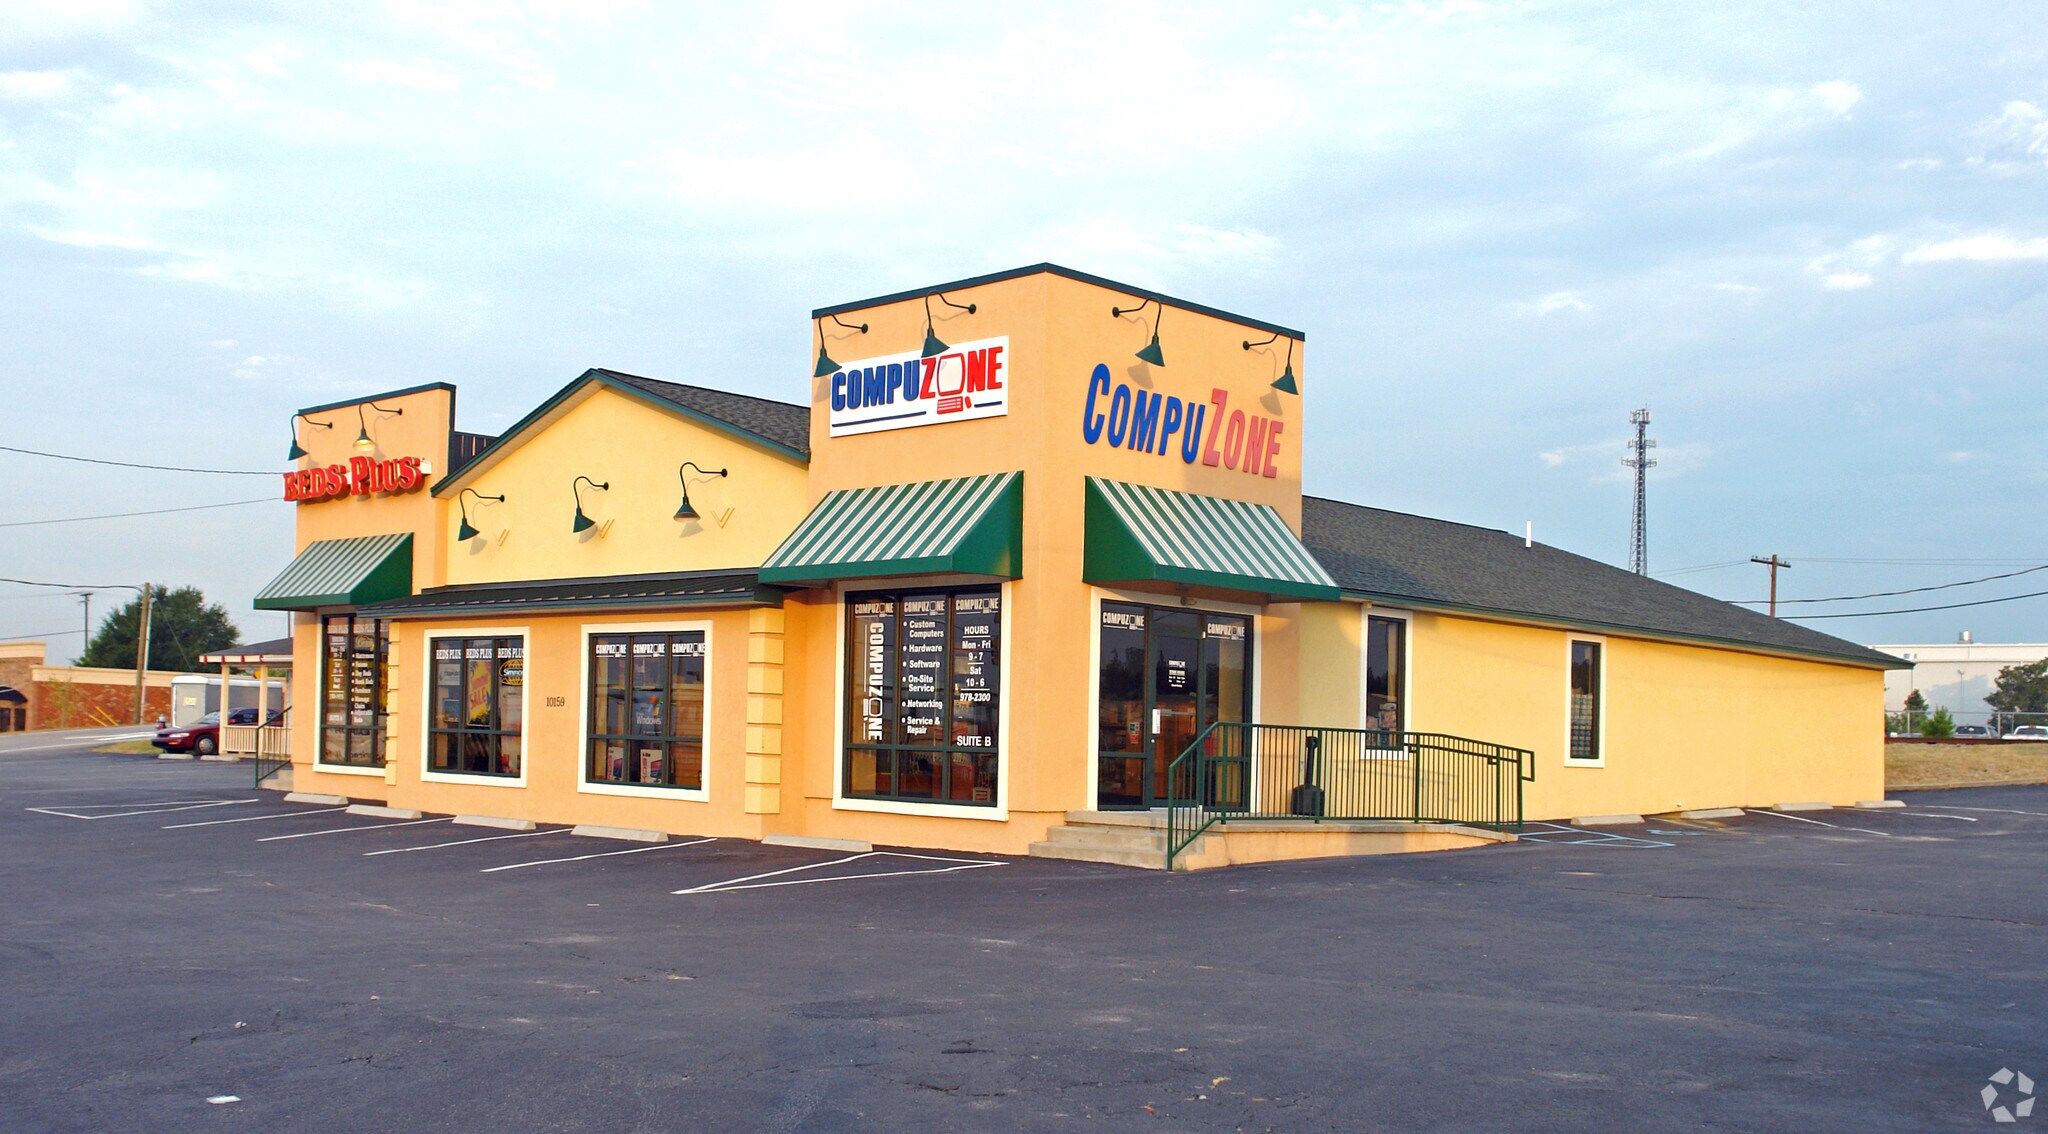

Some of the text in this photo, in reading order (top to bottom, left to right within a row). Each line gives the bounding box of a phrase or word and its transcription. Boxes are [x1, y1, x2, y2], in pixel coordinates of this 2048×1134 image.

[831, 345, 1003, 412] COMPUZONE
[283, 456, 423, 501] BEDS PLUS
[855, 602, 894, 615] COMPUZONE
[904, 601, 945, 614] COMPUZONE
[956, 598, 999, 611] COMPUZONE
[909, 620, 936, 628] Custom
[1103, 612, 1145, 627] COMPUZONE
[909, 630, 944, 639] Computers
[964, 626, 989, 635] HOURS
[1207, 623, 1245, 637] COMPUZONE
[595, 644, 627, 654] COMPUZONE
[633, 643, 665, 654] COMPUZONE
[909, 644, 943, 652] Hardware
[962, 640, 976, 649] Mon
[982, 640, 991, 649] Fri
[436, 649, 461, 659] BEDS PLUS
[466, 648, 493, 659] BEDS PLUS
[497, 647, 511, 658] BEDS
[968, 653, 973, 661] 9
[979, 652, 984, 661] 7
[909, 660, 940, 668] Software
[503, 668, 524, 677] Simmo
[969, 667, 982, 675] Sat
[868, 622, 884, 741] COMPUZONE
[908, 675, 934, 683] On-Site
[965, 678, 974, 687] 10
[980, 678, 985, 687] 6
[908, 684, 935, 693] Service
[546, 696, 566, 707] 10159
[960, 693, 991, 702] 978-2300
[907, 699, 943, 710] Networking
[636, 714, 662, 725] Windows
[907, 717, 941, 725] Service &
[907, 726, 928, 736] Repair
[956, 735, 992, 747] SUITE B
